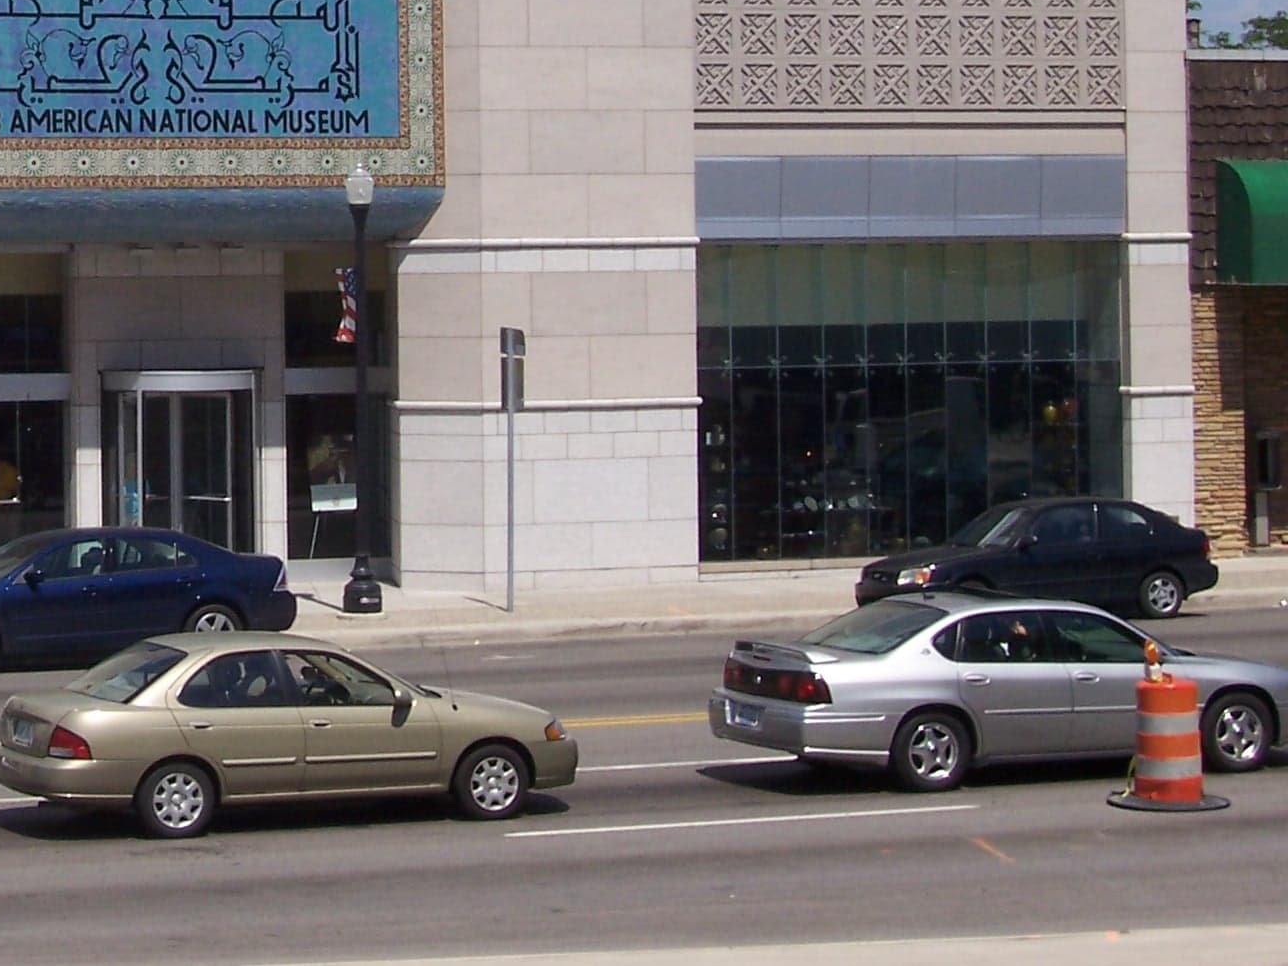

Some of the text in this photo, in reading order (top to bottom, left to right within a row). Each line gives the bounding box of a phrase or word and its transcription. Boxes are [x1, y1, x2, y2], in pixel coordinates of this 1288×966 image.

[9, 107, 132, 135] AMERICAN
[138, 108, 258, 134] NATIONAL
[263, 107, 370, 135] MUSEUM
